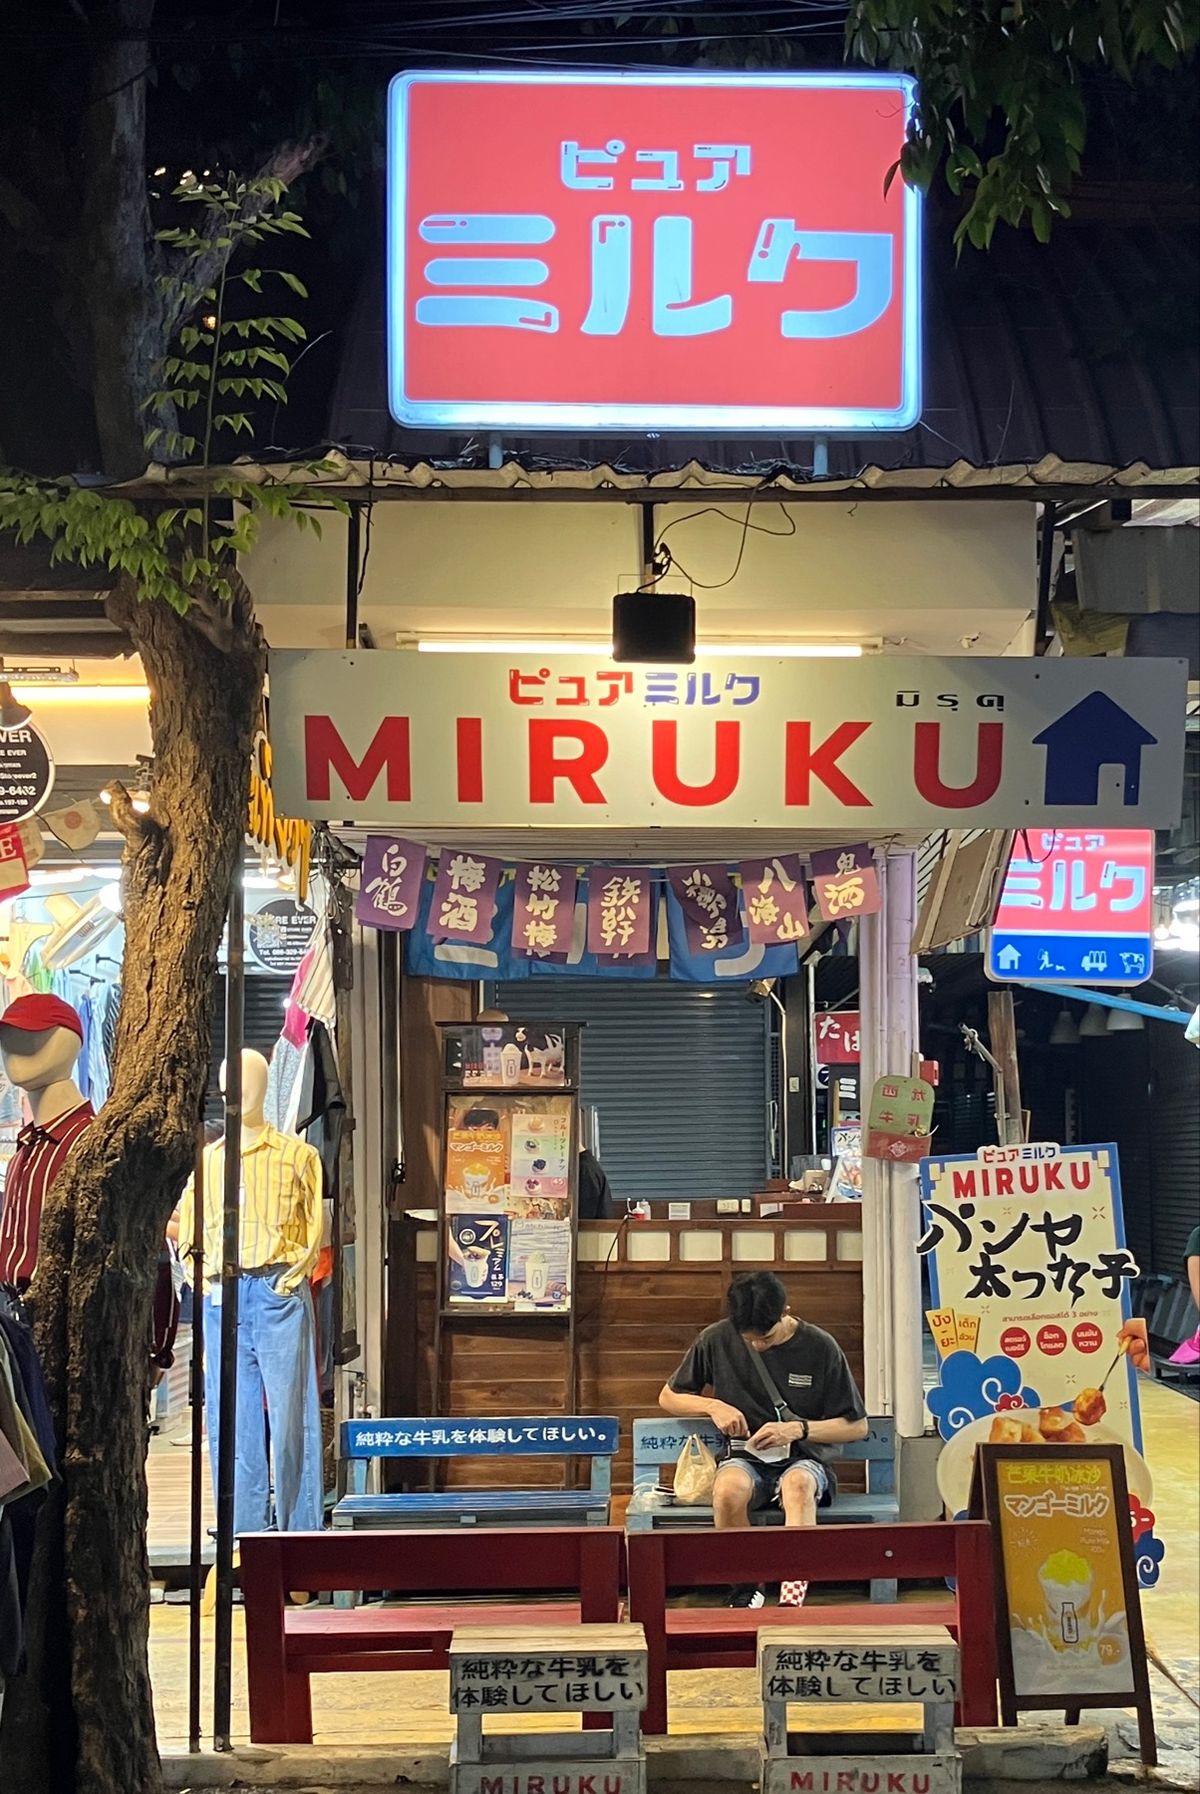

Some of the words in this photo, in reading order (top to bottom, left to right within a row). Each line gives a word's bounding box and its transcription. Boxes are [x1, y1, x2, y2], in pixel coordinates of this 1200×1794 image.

[561, 139, 752, 191] ピュア
[415, 214, 893, 338] ミルク
[509, 668, 760, 706] ピュアミルク
[304, 714, 1003, 809] MIRUKU
[1041, 832, 1105, 851] ピュア
[1000, 858, 1146, 912] ミルク
[523, 865, 561, 947] 松竹梅
[983, 1146, 1057, 1163] ピュアミルク
[952, 1161, 1092, 1199] MIRUKU
[916, 1202, 1083, 1260] パンヤ
[964, 1252, 1137, 1308] 太った子
[355, 1426, 607, 1447] 純粋な牛乳を体験してほしい。
[1004, 1489, 1110, 1517] マンゴーミルク
[461, 1657, 630, 1680] 純粋な牛乳を
[775, 1650, 942, 1672] 純粋な牛乳を
[453, 1681, 644, 1708] 体験してほしい
[767, 1675, 957, 1697] 体験してほしい
[480, 1775, 622, 1794] MIRUKU
[790, 1771, 930, 1794] MIRUKU
